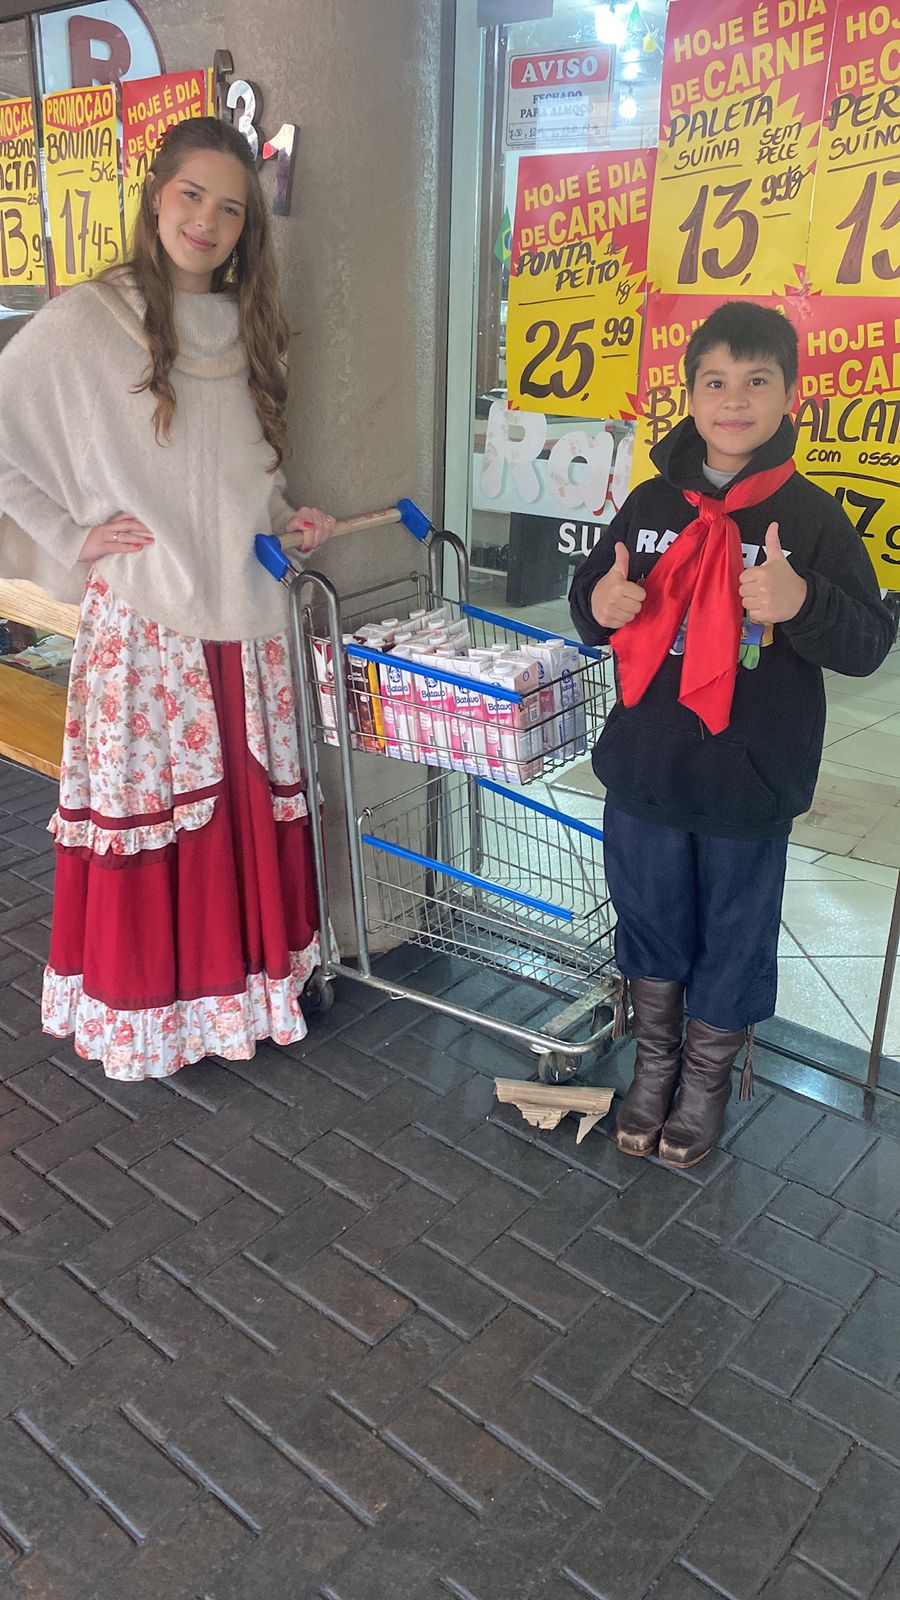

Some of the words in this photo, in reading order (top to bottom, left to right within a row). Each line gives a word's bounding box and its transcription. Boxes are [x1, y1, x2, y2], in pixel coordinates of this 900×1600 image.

[673, 17, 744, 64] HOJE
[752, 3, 769, 38] É
[777, 0, 827, 29] DIA
[520, 55, 598, 84] AVISO
[671, 78, 702, 107] DE
[703, 23, 825, 99] CARNE
[840, 58, 875, 91] DE
[47, 91, 112, 126] PROMOÇÃO
[128, 93, 163, 126] HOJE
[163, 85, 174, 109] É
[175, 78, 201, 105] DIA
[667, 92, 774, 148] PALETA
[759, 122, 802, 146] SEM
[46, 127, 112, 165] BONINA
[128, 135, 144, 155] DE
[755, 143, 799, 165] PELE
[524, 174, 581, 211] HOJE
[586, 165, 602, 195] É
[607, 158, 648, 190] DIA
[520, 224, 546, 248] DE
[548, 187, 647, 244] CARNE
[517, 240, 592, 277] PONTA
[807, 321, 884, 357] HOJE
[648, 365, 676, 388] DE
[802, 372, 834, 397] DE
[421, 690, 445, 698] Batavo
[456, 695, 479, 704] Batavo
